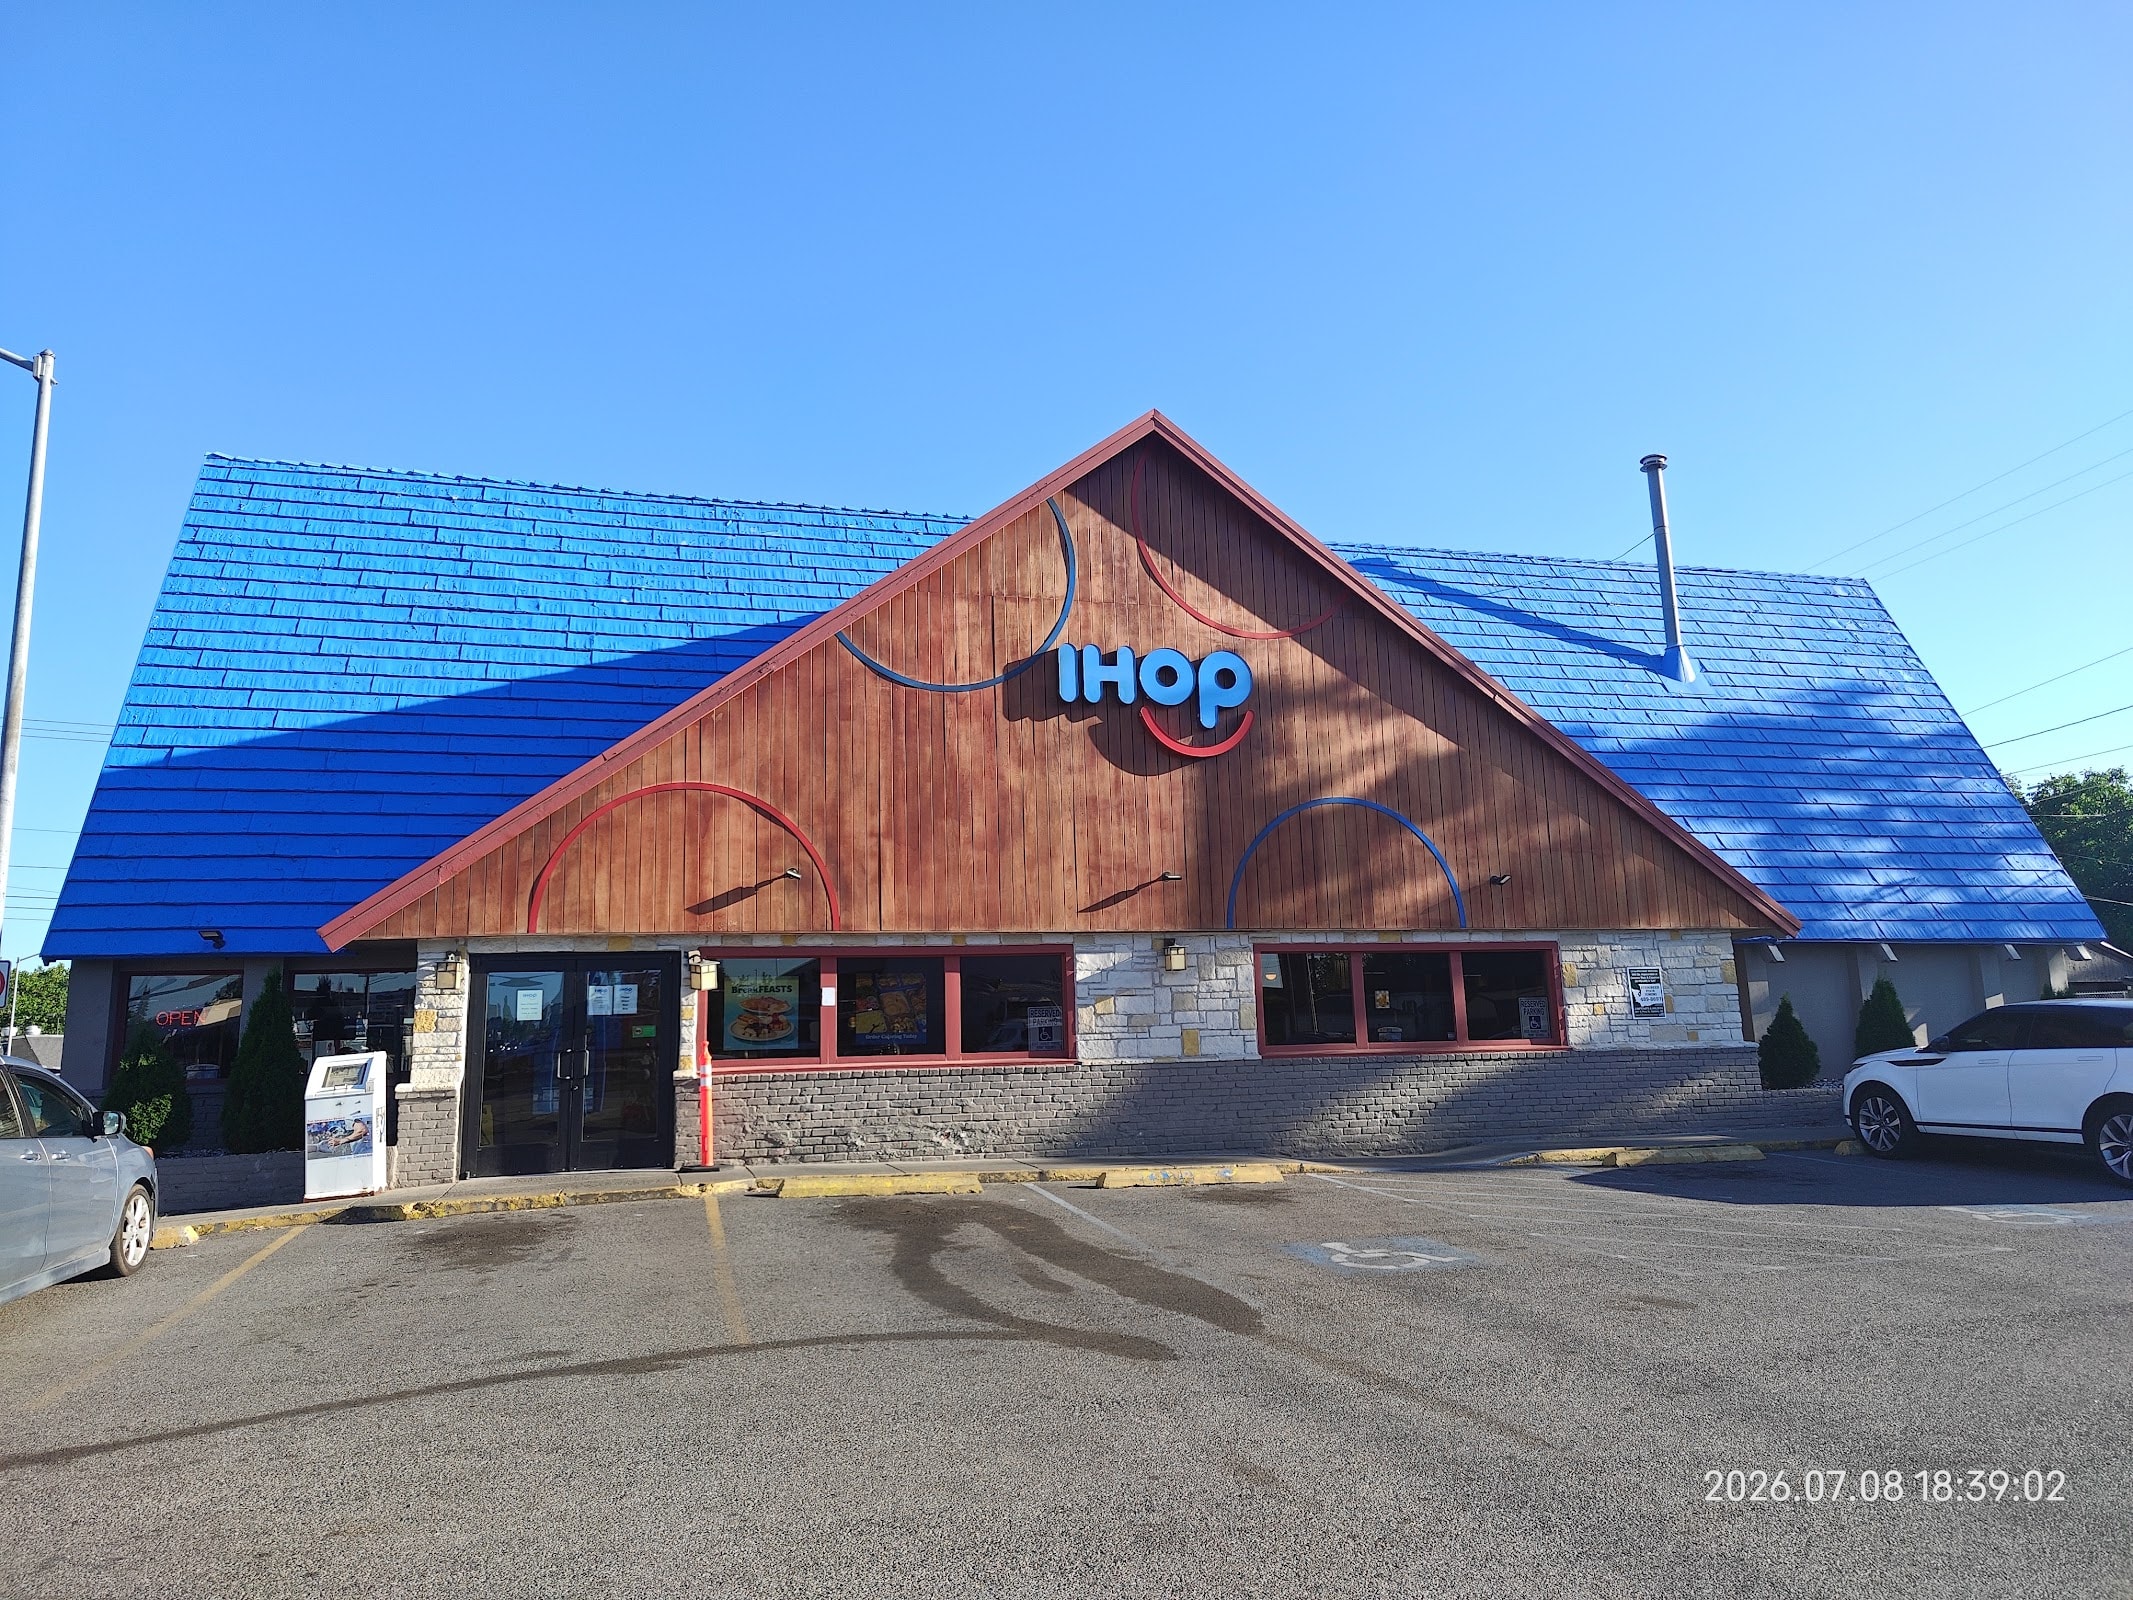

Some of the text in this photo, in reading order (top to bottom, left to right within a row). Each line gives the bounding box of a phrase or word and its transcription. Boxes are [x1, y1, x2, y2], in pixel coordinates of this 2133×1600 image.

[1030, 1009, 1060, 1018] RESERVED
[1523, 1007, 1545, 1015] PARKING
[156, 1010, 206, 1025] OPEN
[1032, 1018, 1058, 1026] PARKING
